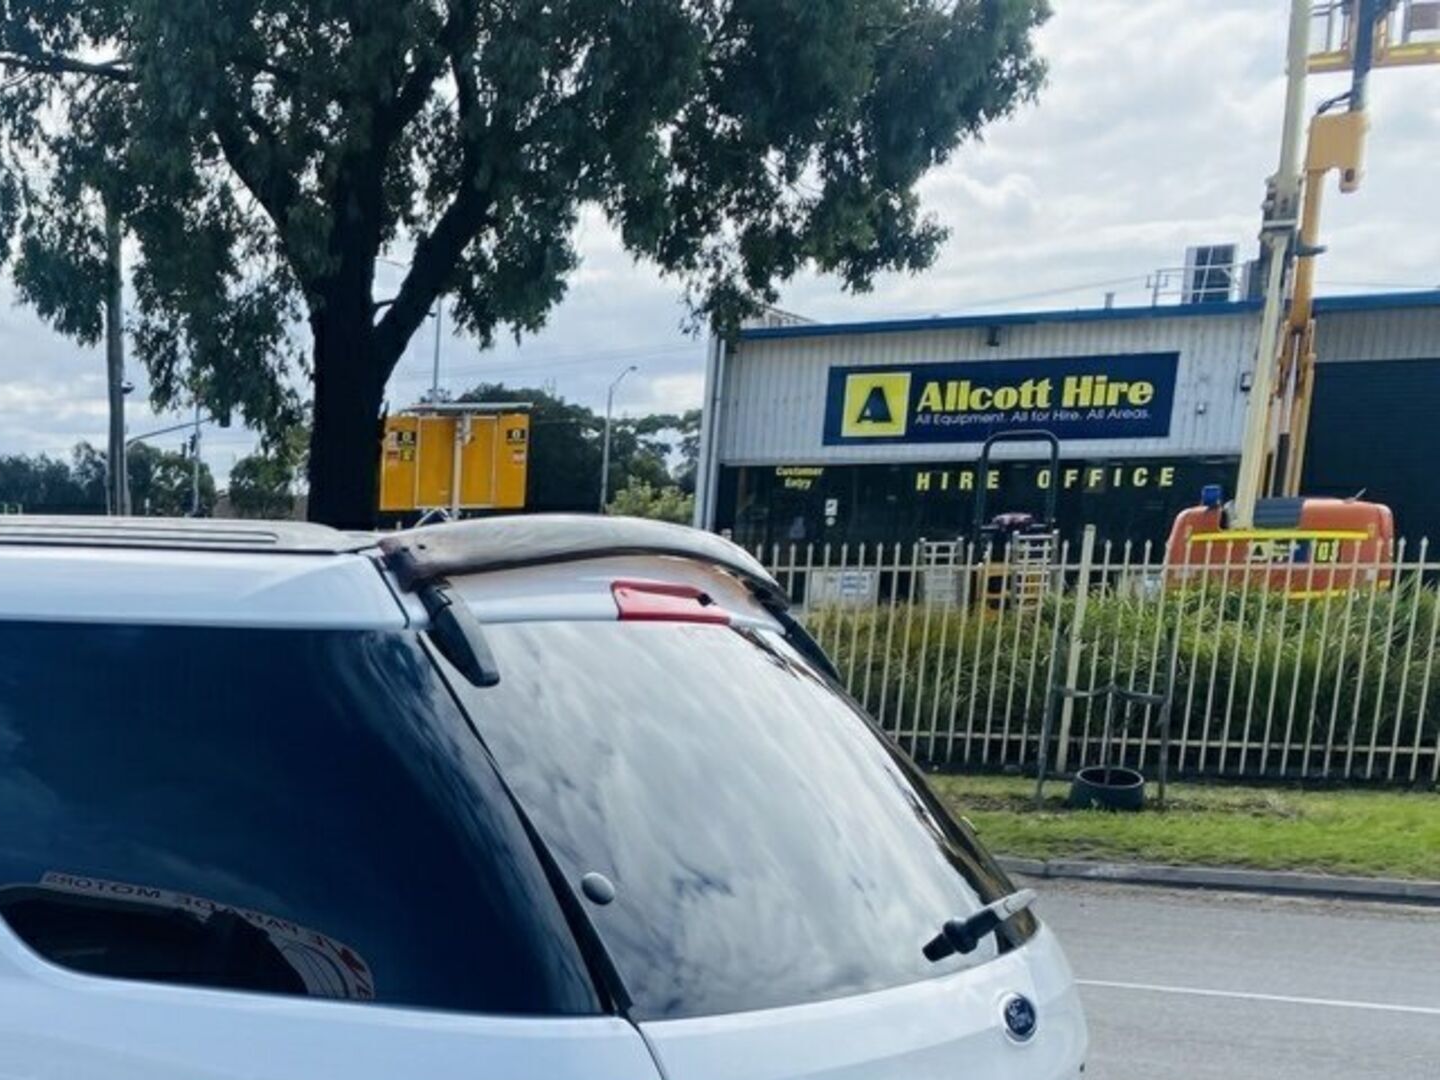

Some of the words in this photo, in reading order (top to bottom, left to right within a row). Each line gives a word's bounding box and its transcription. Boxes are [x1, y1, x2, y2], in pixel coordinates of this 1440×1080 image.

[917, 378, 1052, 412] Allcott
[1062, 375, 1154, 407] Hire
[856, 386, 892, 424] A
[915, 413, 931, 425] All
[933, 412, 1006, 426] Equipment.
[1011, 411, 1028, 422] All
[1031, 410, 1049, 422] for
[1052, 409, 1082, 421] Hire.
[1086, 408, 1104, 420] All
[1109, 407, 1150, 420] Areas.
[775, 467, 823, 476] Customer
[916, 470, 999, 491] HIRE
[1037, 467, 1175, 489] OFFICE
[784, 478, 811, 490] Entry
